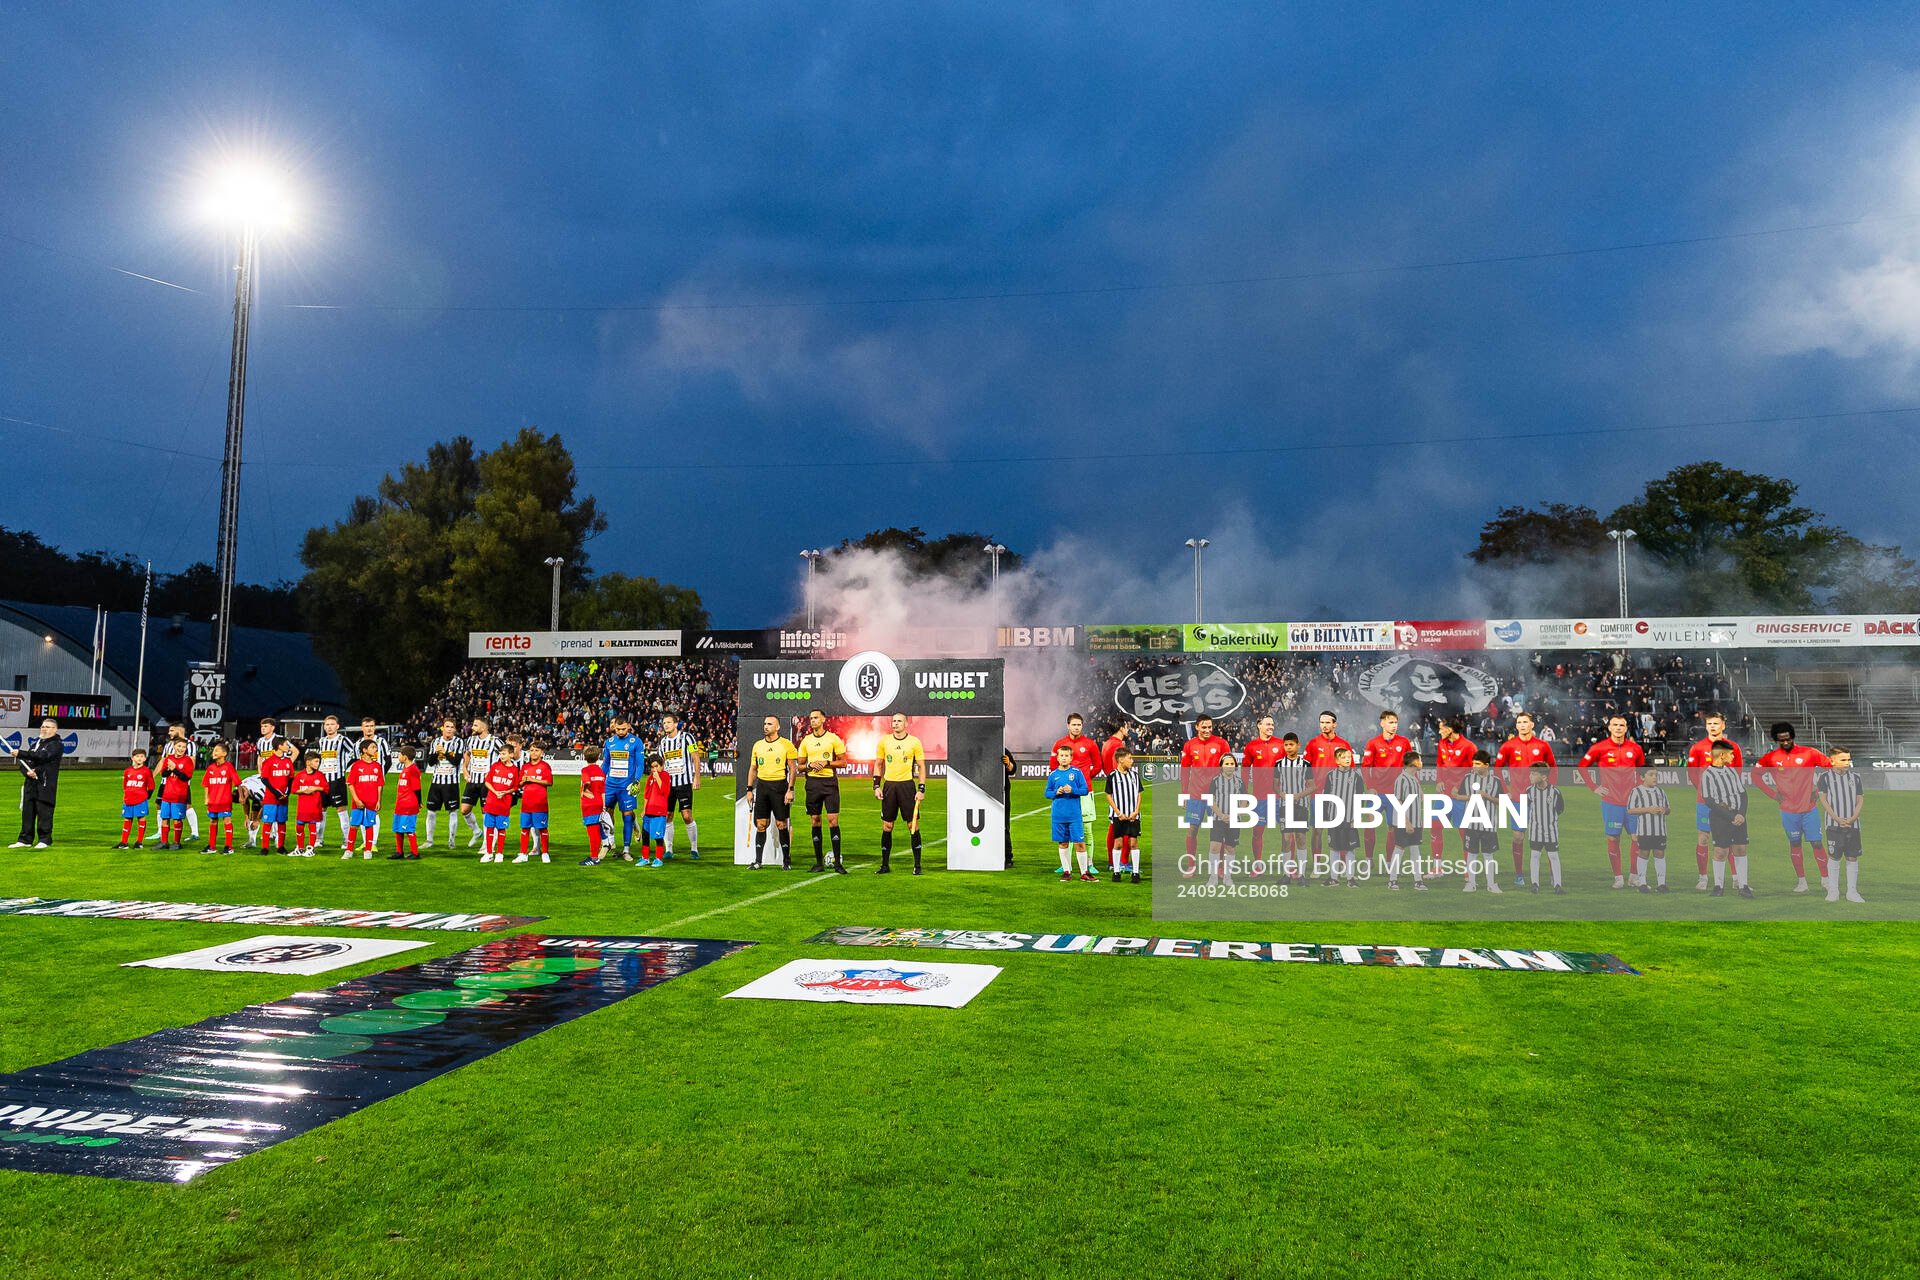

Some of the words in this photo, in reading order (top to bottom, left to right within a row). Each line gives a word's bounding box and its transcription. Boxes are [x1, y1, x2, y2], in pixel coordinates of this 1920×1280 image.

[1539, 624, 1571, 633] COMFORT
[1600, 624, 1633, 632] COMFORT
[1756, 622, 1852, 634] RINGSERVICE
[1864, 620, 1916, 635] DÄCK
[486, 634, 531, 650] renta
[561, 637, 592, 650] prenad
[599, 639, 678, 648] LOKALTIDNINGEN
[714, 640, 753, 649] Mäklarhuset
[780, 630, 847, 650] infosign
[1013, 627, 1075, 647] BBM
[1210, 633, 1279, 648] bakertilly
[753, 672, 824, 689] UNIBET
[914, 672, 989, 688] UNIBET
[1126, 670, 1235, 697] HEJA
[33, 703, 107, 719] HEMMAKVÄLL
[966, 808, 985, 834] U
[537, 938, 698, 951] UNIBET
[974, 931, 1574, 971] SUPERETTAN
